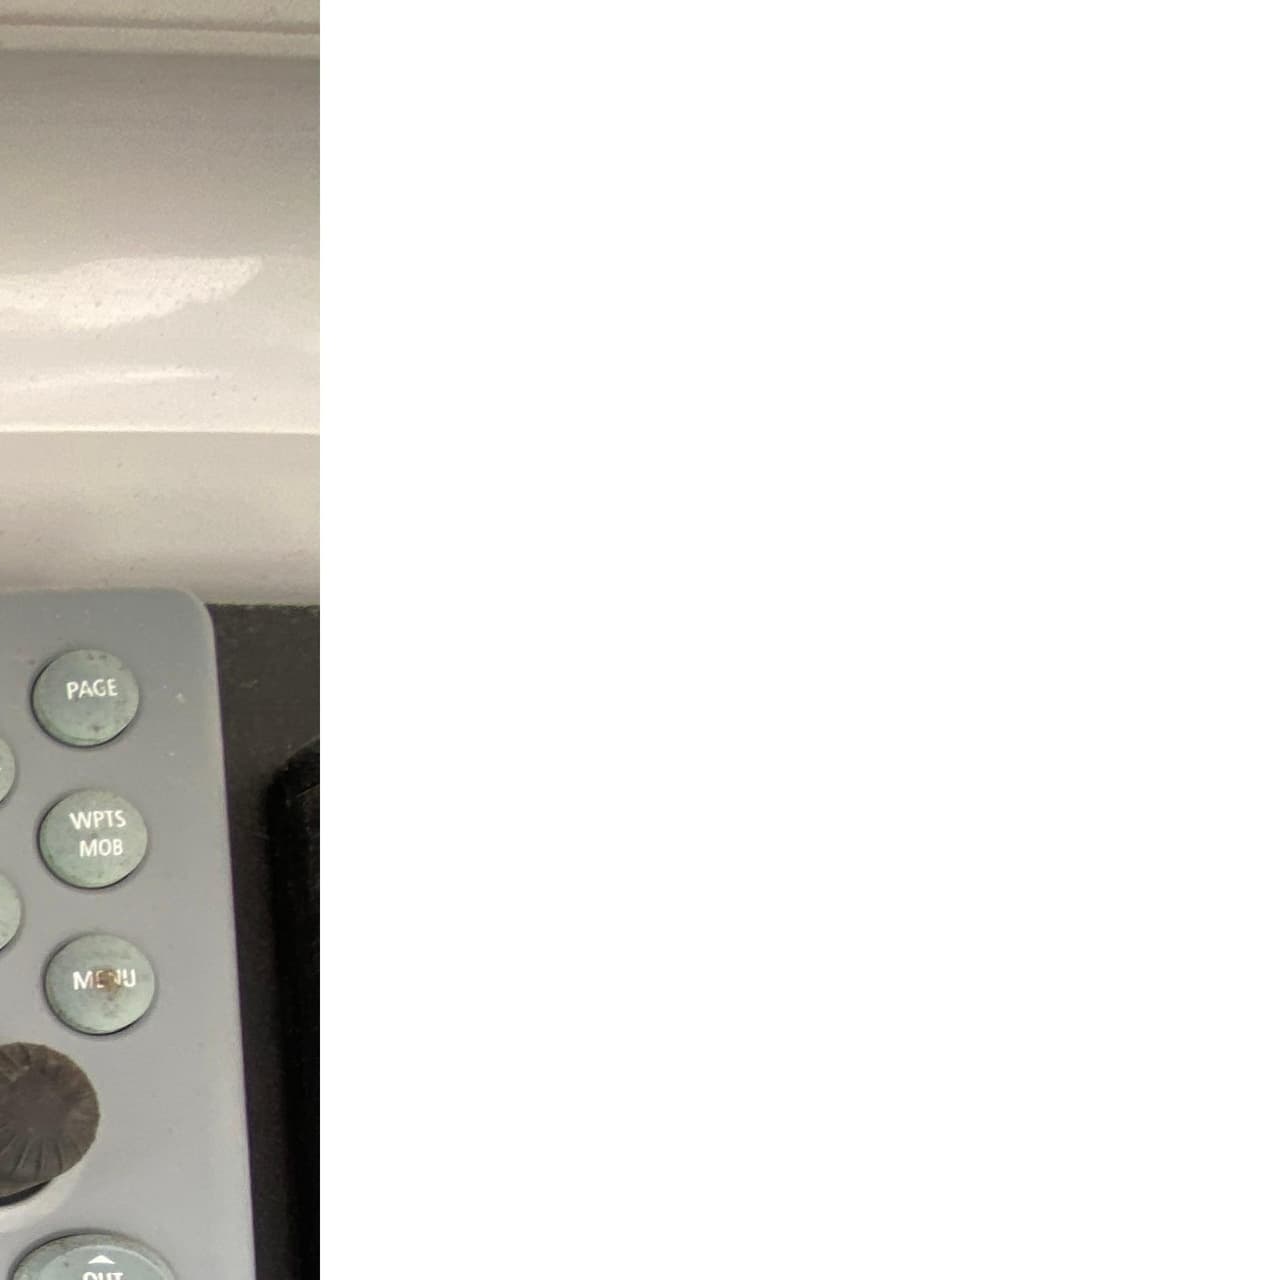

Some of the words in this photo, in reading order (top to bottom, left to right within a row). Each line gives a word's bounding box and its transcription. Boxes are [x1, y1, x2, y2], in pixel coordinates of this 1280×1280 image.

[66, 678, 118, 700] PAGE
[69, 810, 126, 830] WPTS
[79, 838, 123, 857] MOB
